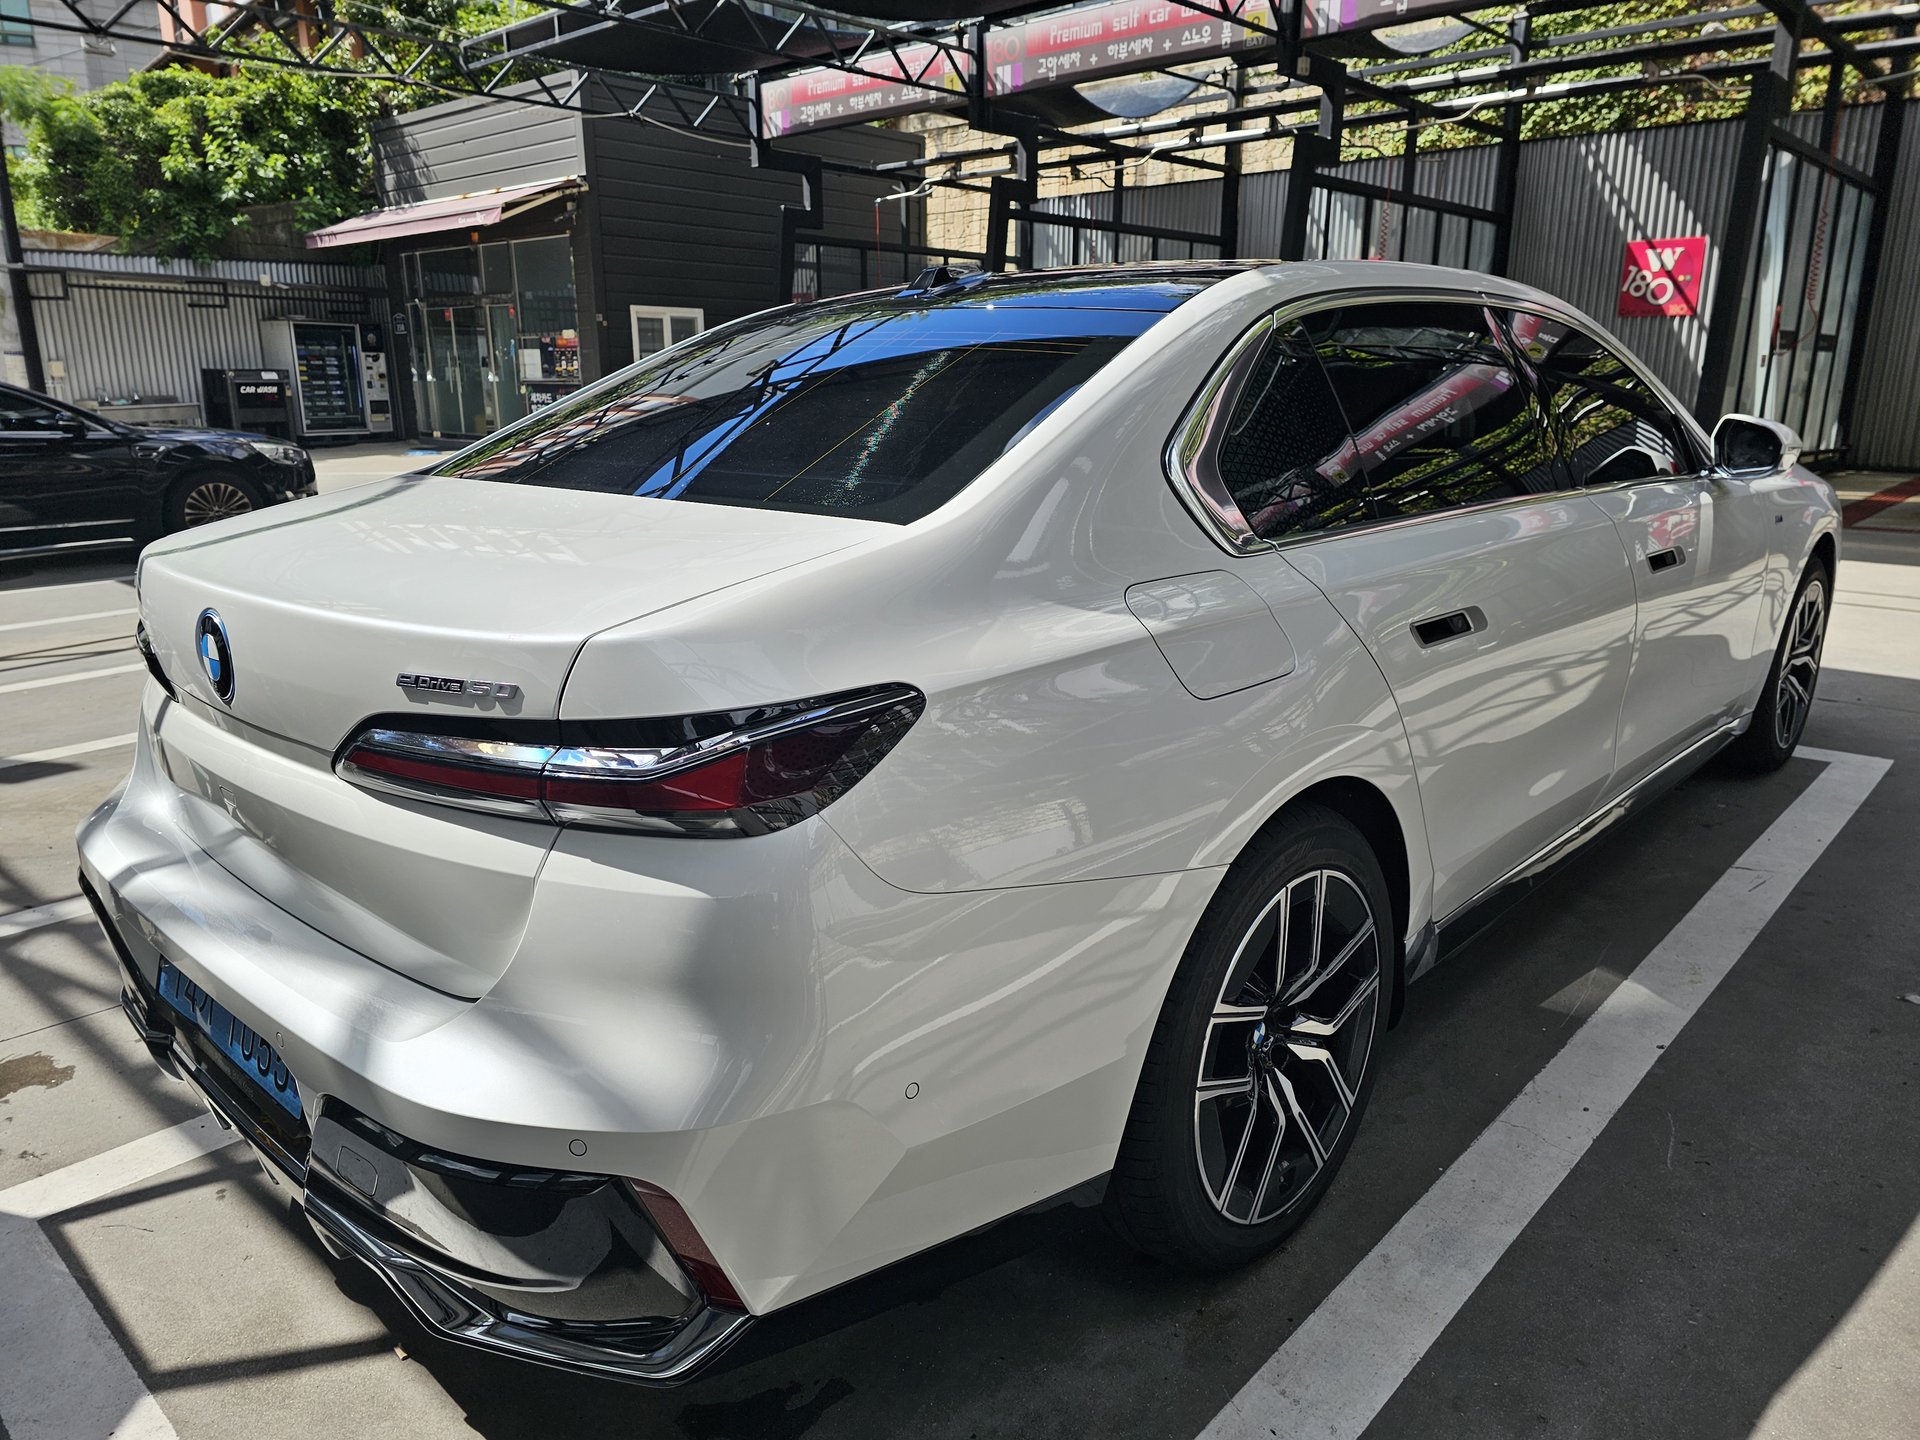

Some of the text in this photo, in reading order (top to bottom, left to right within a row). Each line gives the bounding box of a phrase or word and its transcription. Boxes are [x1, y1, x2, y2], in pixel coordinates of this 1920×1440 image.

[1049, 21, 1103, 46] Premium
[1112, 10, 1140, 32] self
[1149, 7, 1171, 25] car
[1037, 50, 1081, 81] 고압세차
[1107, 36, 1154, 60] 하부세차
[1181, 25, 1212, 46] 스노우
[1221, 21, 1233, 50] 폼
[807, 78, 846, 97] Premium
[1645, 246, 1686, 273] W
[1621, 264, 1675, 306] 180
[240, 385, 278, 394] CAR WASH
